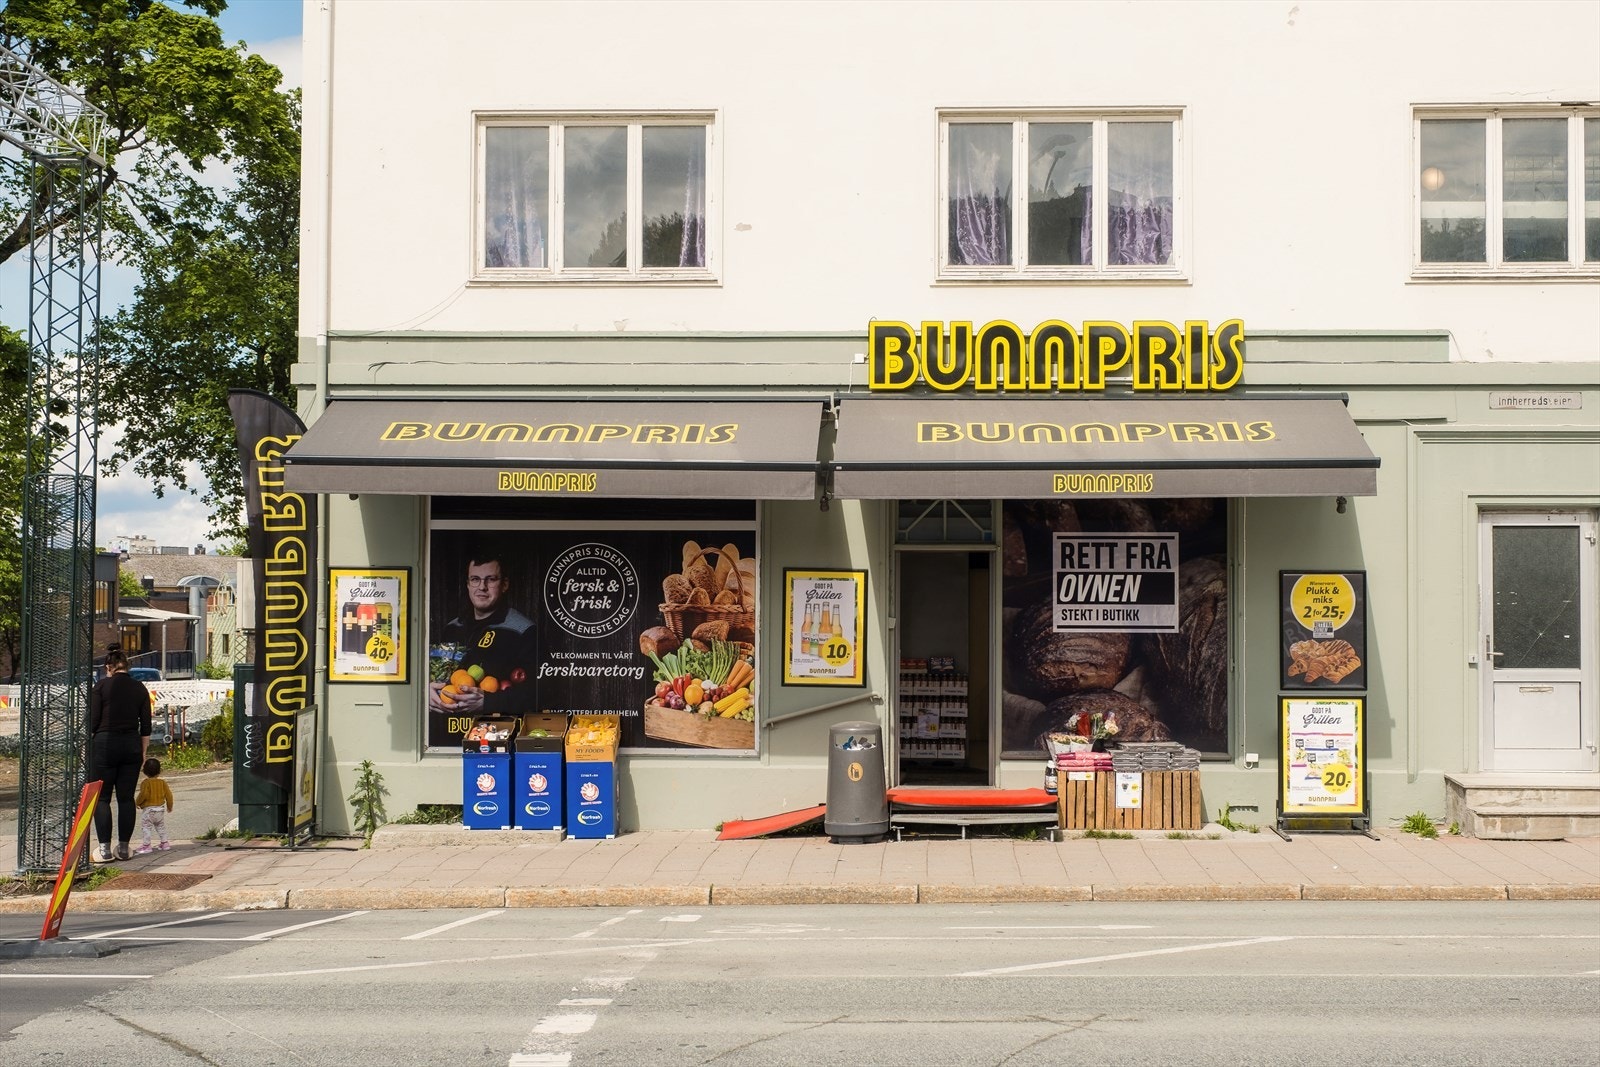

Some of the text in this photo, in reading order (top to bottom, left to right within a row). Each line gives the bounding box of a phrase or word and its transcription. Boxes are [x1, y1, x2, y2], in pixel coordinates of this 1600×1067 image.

[868, 319, 1244, 391] BUNNPRIS
[379, 421, 739, 445] BUNNPRIS
[917, 421, 1276, 444] BUNNPRIS
[499, 471, 597, 492] BUNNPRIS
[1053, 473, 1154, 493] BUNNPRIS
[1060, 542, 1172, 569] RETT FRA
[550, 547, 635, 587] BUNNPRIS SIDEN 1981
[576, 567, 607, 576] ALLTID
[349, 587, 387, 601] Grillen
[562, 578, 620, 595] fersk &
[1059, 573, 1142, 603] OVNEN
[1306, 586, 1340, 595] Plukk &
[571, 595, 612, 612] frisk
[805, 589, 843, 603] Grillen
[1312, 595, 1333, 604] miks
[553, 606, 630, 635] HVER ENESTE DAG
[1061, 608, 1140, 621] STEKT I BUTIKK
[1303, 606, 1312, 618] 2
[1313, 608, 1322, 617] for
[550, 650, 633, 660] VELKOMMEN TIL VÅRT
[536, 662, 645, 680] ferskvaretorg
[1302, 713, 1342, 728] Grillen
